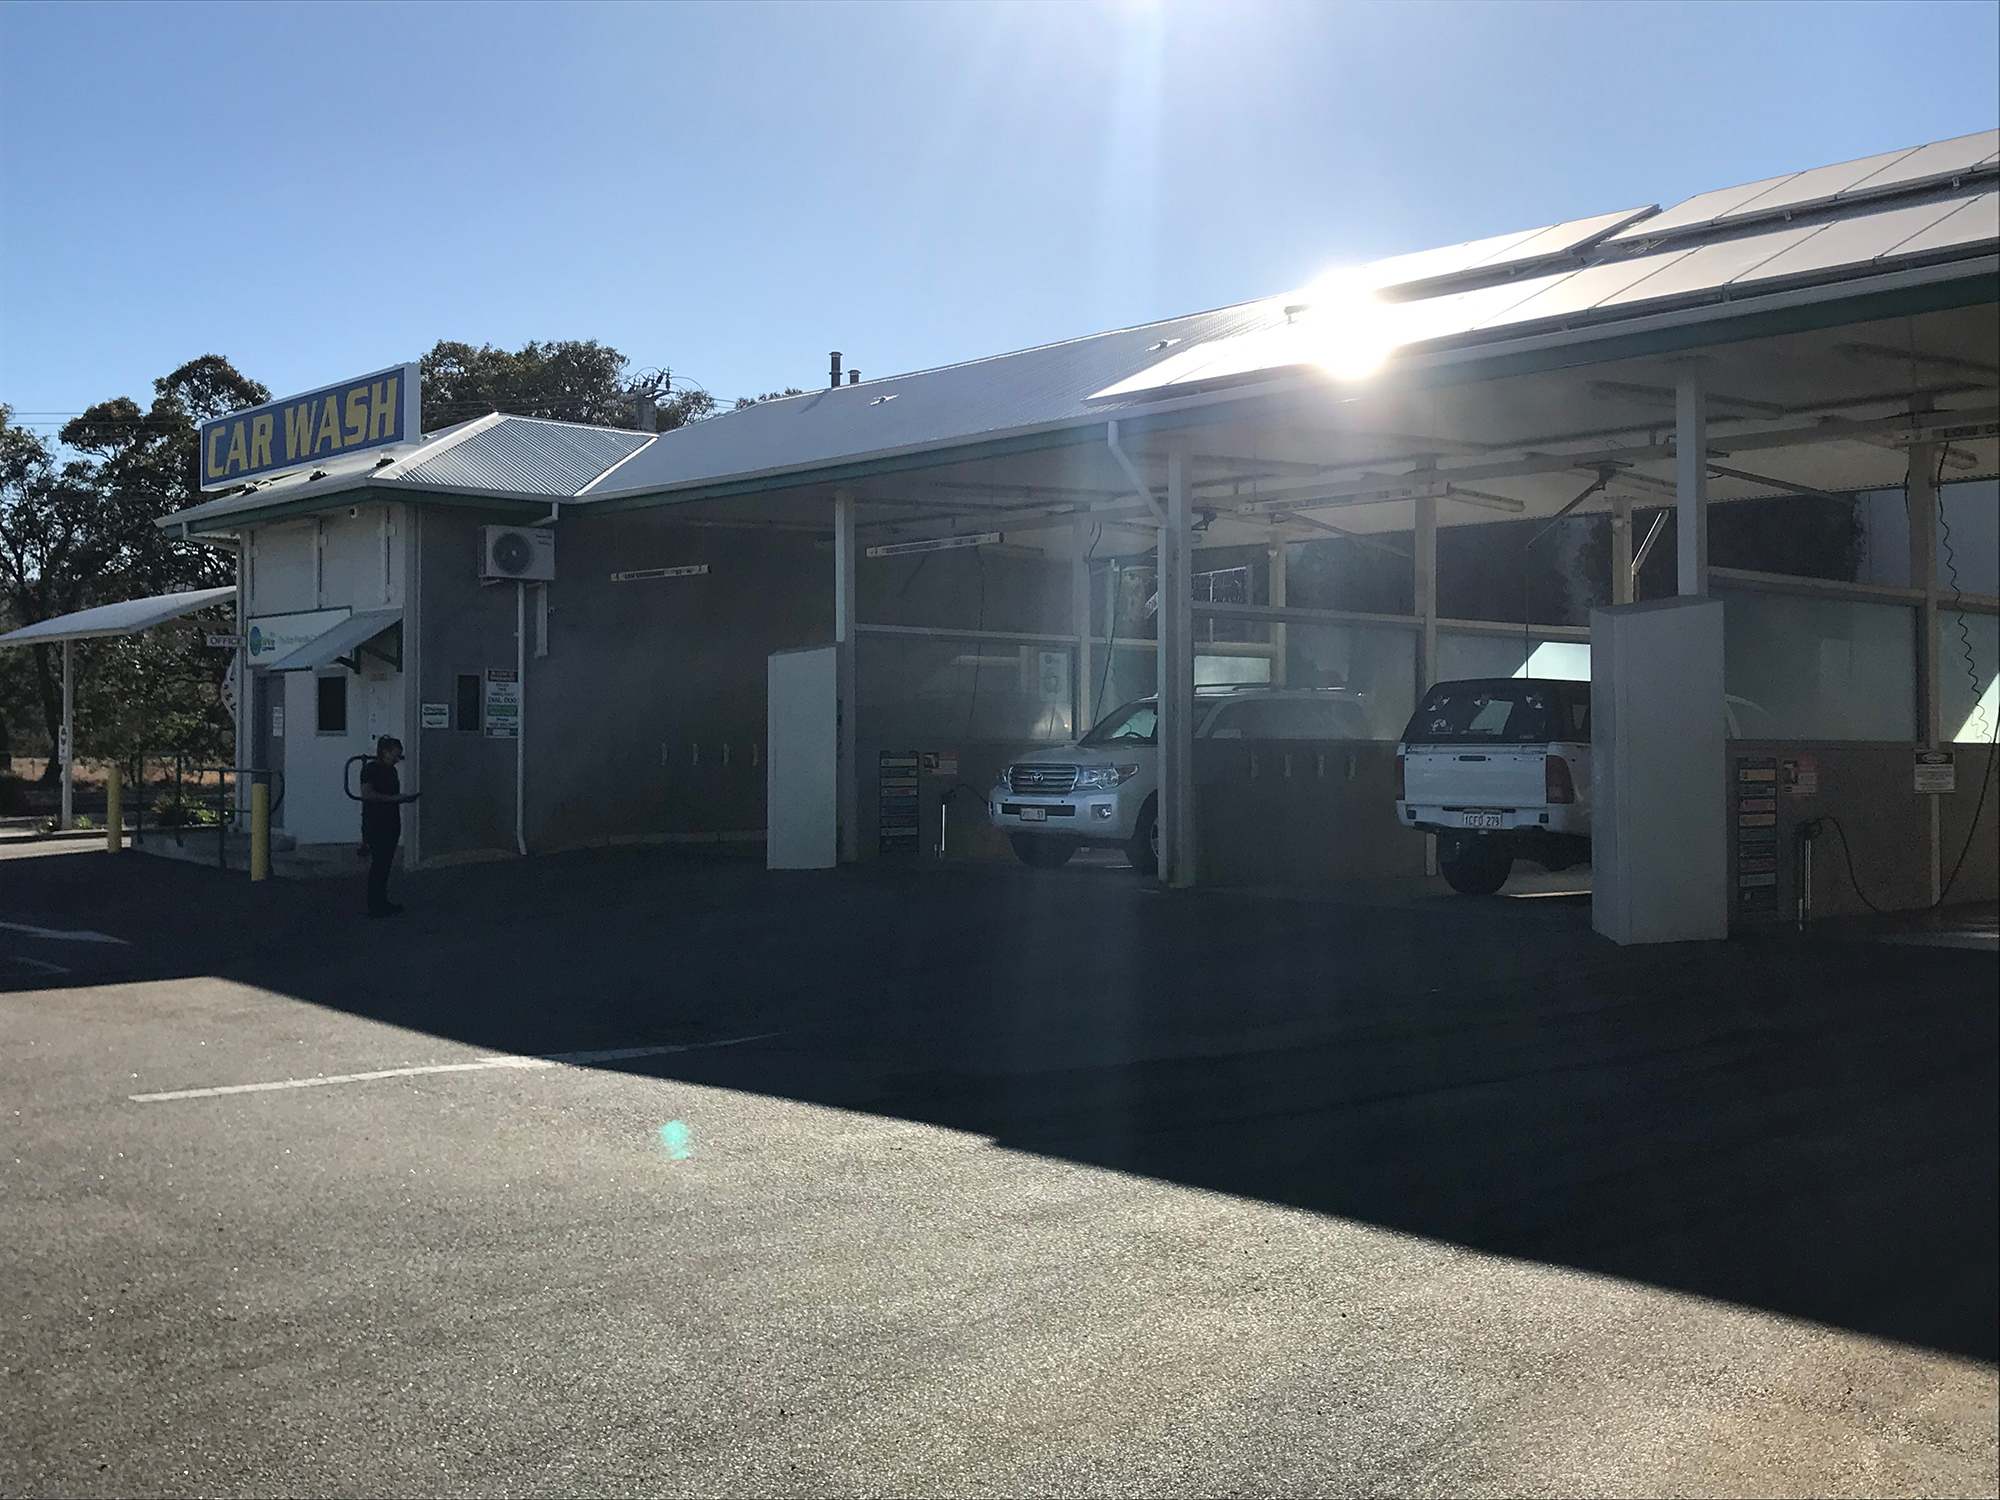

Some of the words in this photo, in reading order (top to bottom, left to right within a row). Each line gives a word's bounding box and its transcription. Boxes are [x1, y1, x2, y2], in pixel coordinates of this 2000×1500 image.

[207, 413, 273, 478] CAR
[284, 377, 398, 460] WASH
[210, 636, 242, 645] OFFICE
